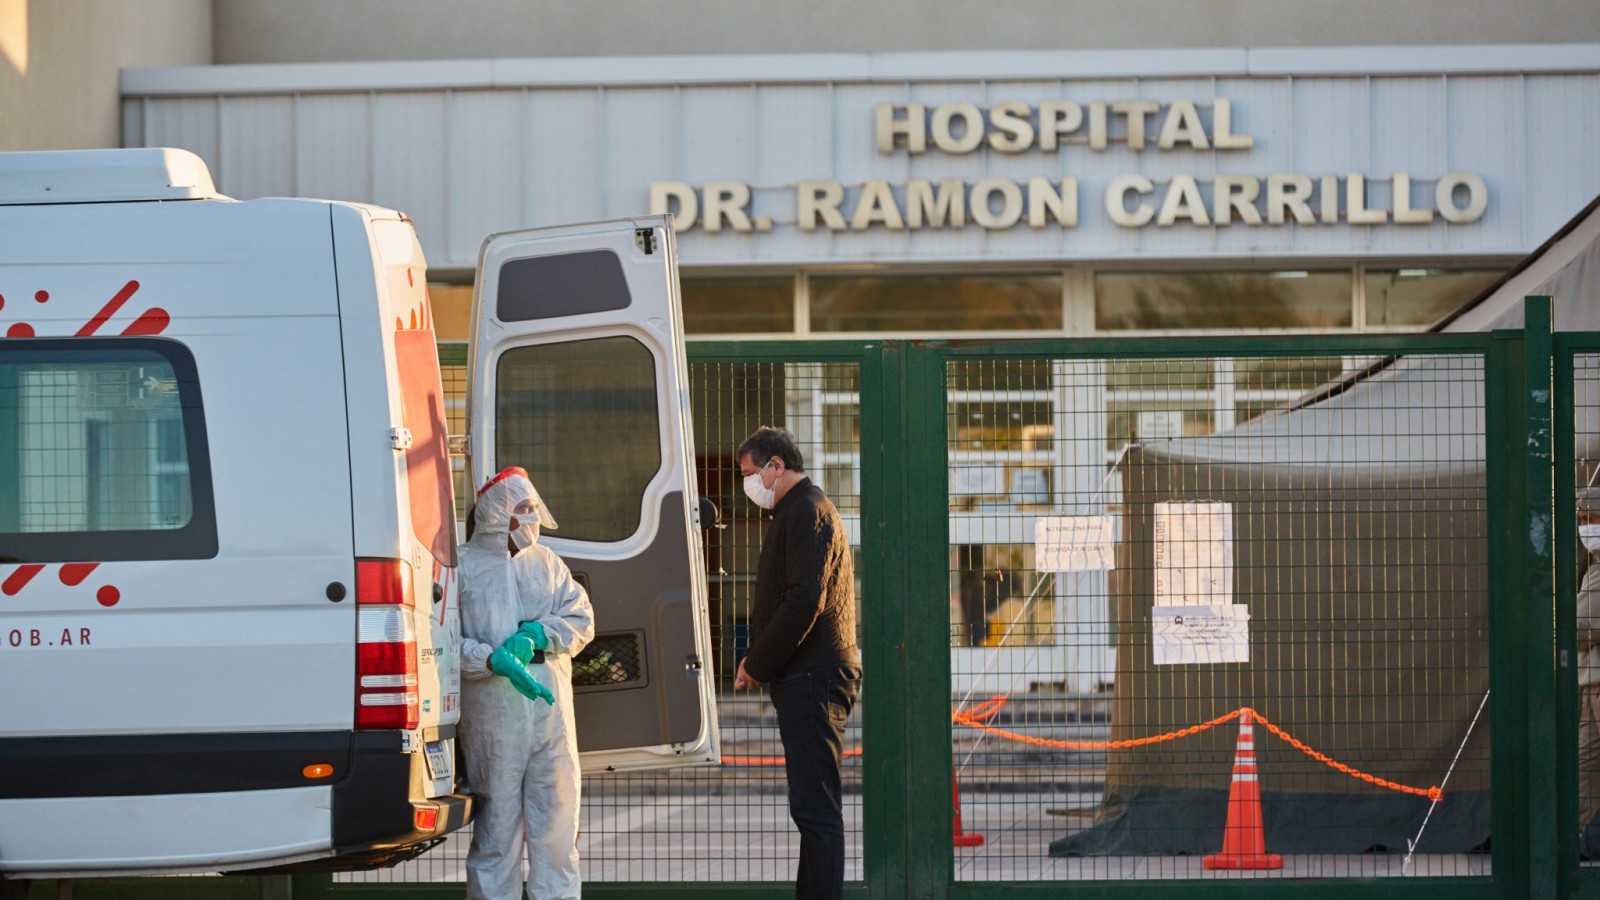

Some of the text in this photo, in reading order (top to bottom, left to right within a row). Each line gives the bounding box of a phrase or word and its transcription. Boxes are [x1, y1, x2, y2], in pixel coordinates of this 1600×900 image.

[876, 98, 1254, 155] HOSPITAL
[650, 171, 1488, 233] DR. RAMON CARRILLO
[0, 628, 91, 647] OB.AR
